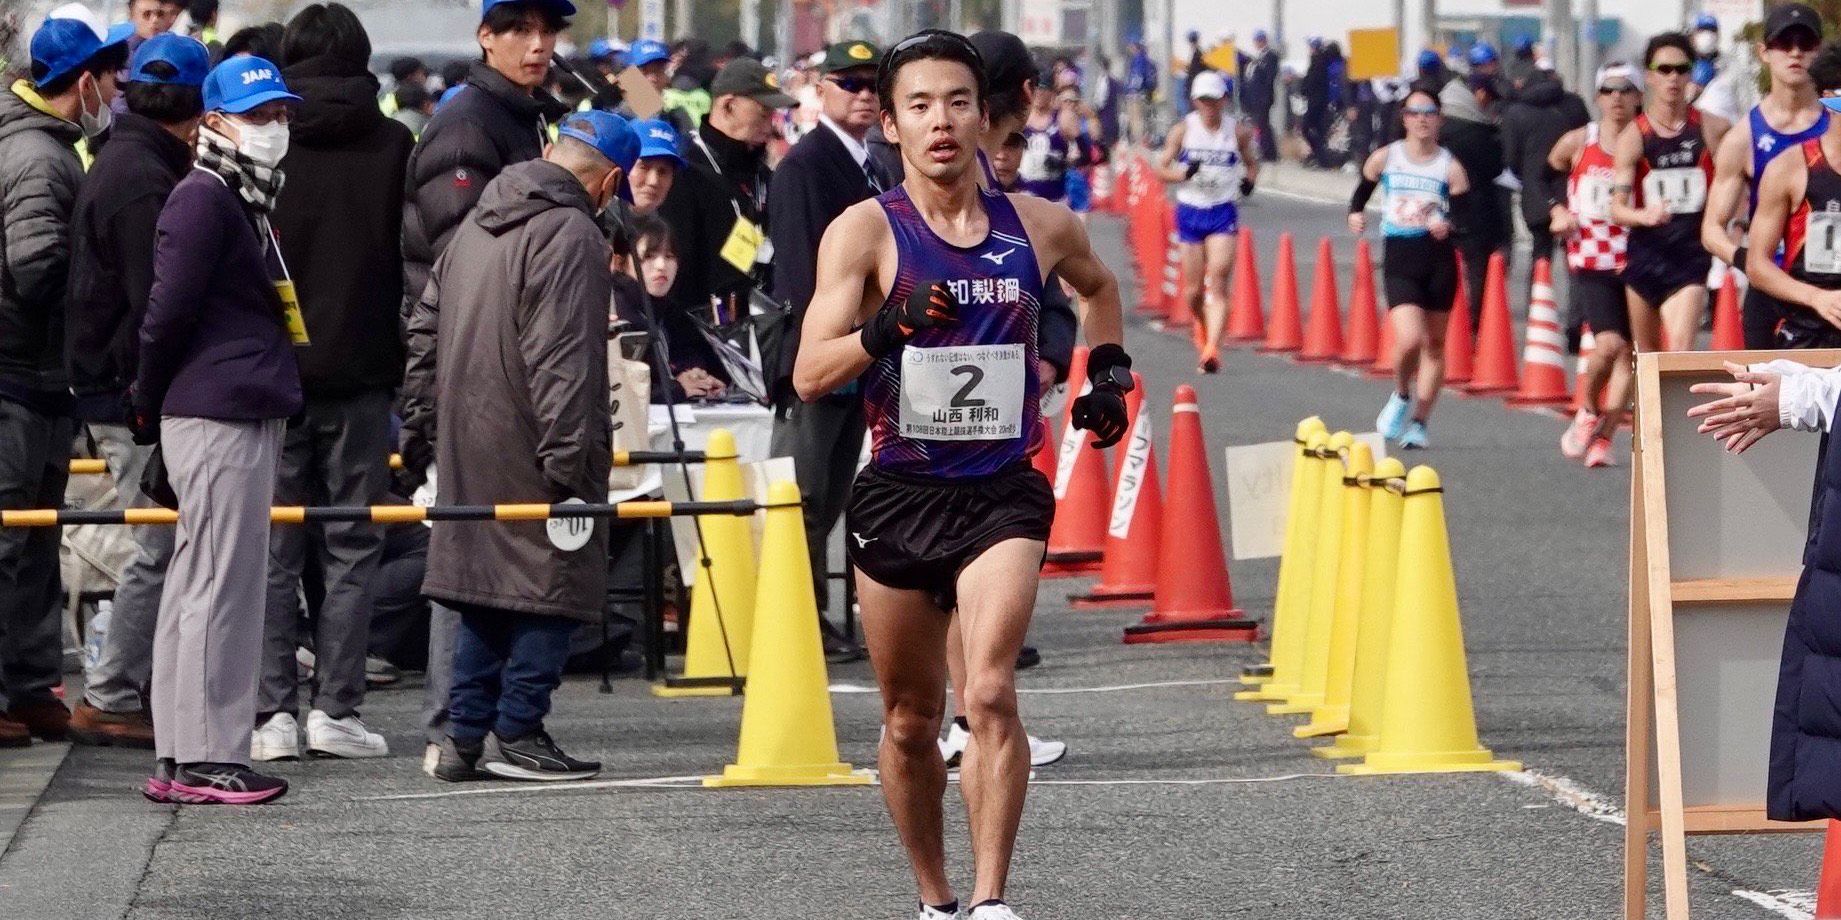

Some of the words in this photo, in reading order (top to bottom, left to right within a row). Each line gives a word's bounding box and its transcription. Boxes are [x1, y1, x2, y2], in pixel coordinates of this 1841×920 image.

[947, 278, 1019, 305] 知製鋼
[950, 364, 986, 407] 2
[932, 408, 963, 423] 山西
[968, 406, 999, 422] 利和
